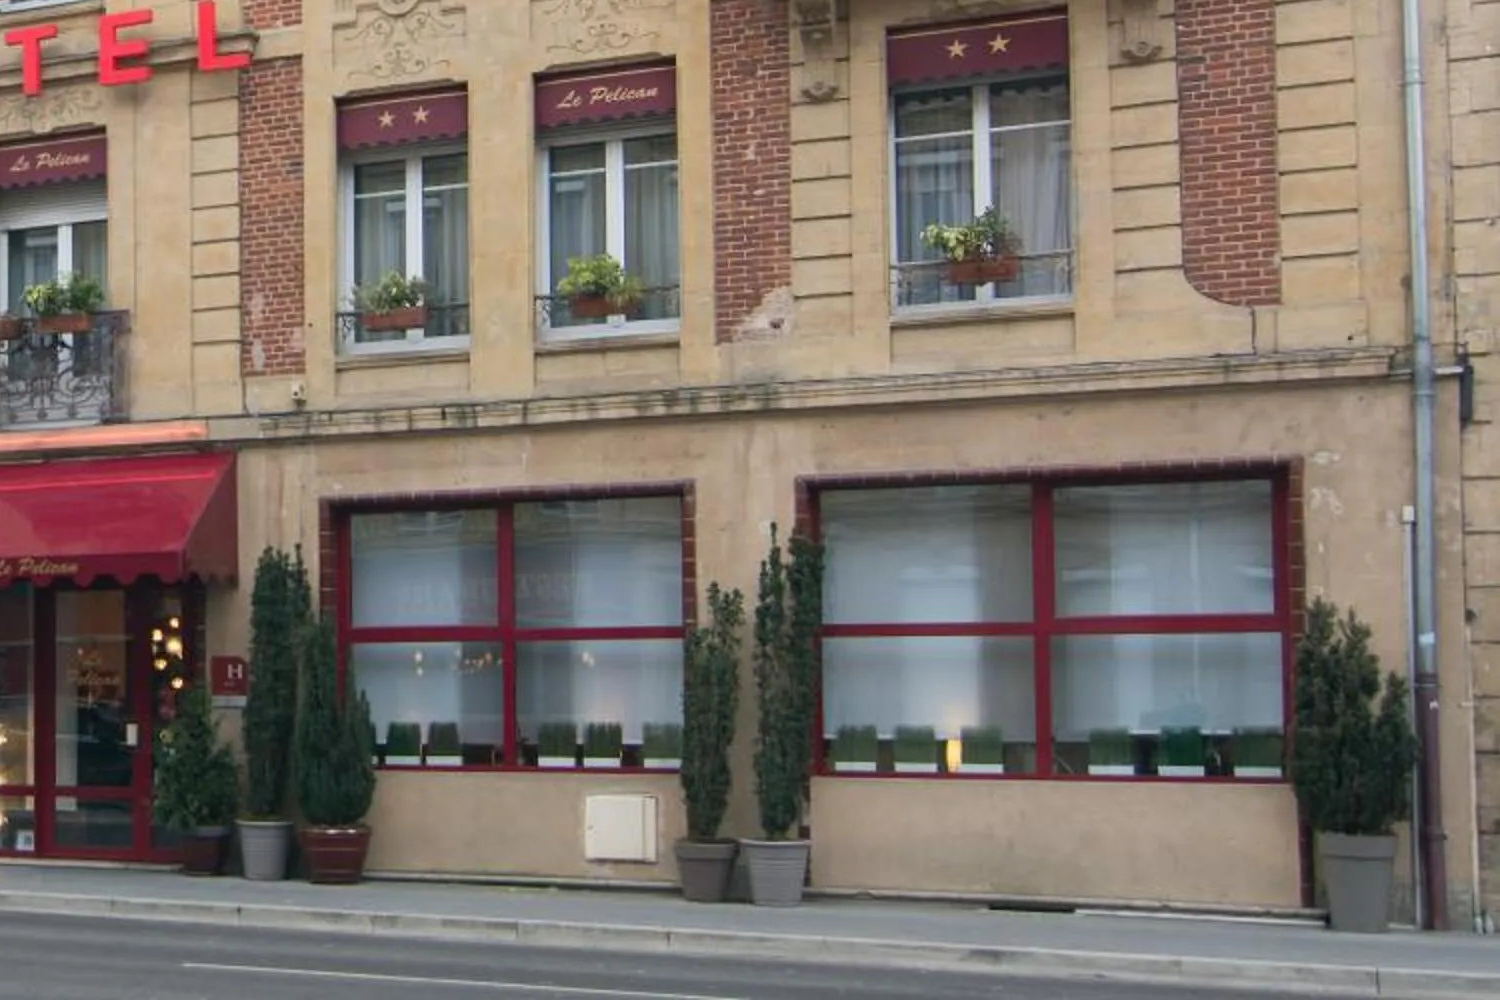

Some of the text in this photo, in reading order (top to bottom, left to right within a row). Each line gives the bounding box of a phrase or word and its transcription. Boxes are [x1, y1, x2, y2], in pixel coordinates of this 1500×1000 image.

[555, 86, 660, 109] Le Pelican
[227, 663, 243, 680] H
